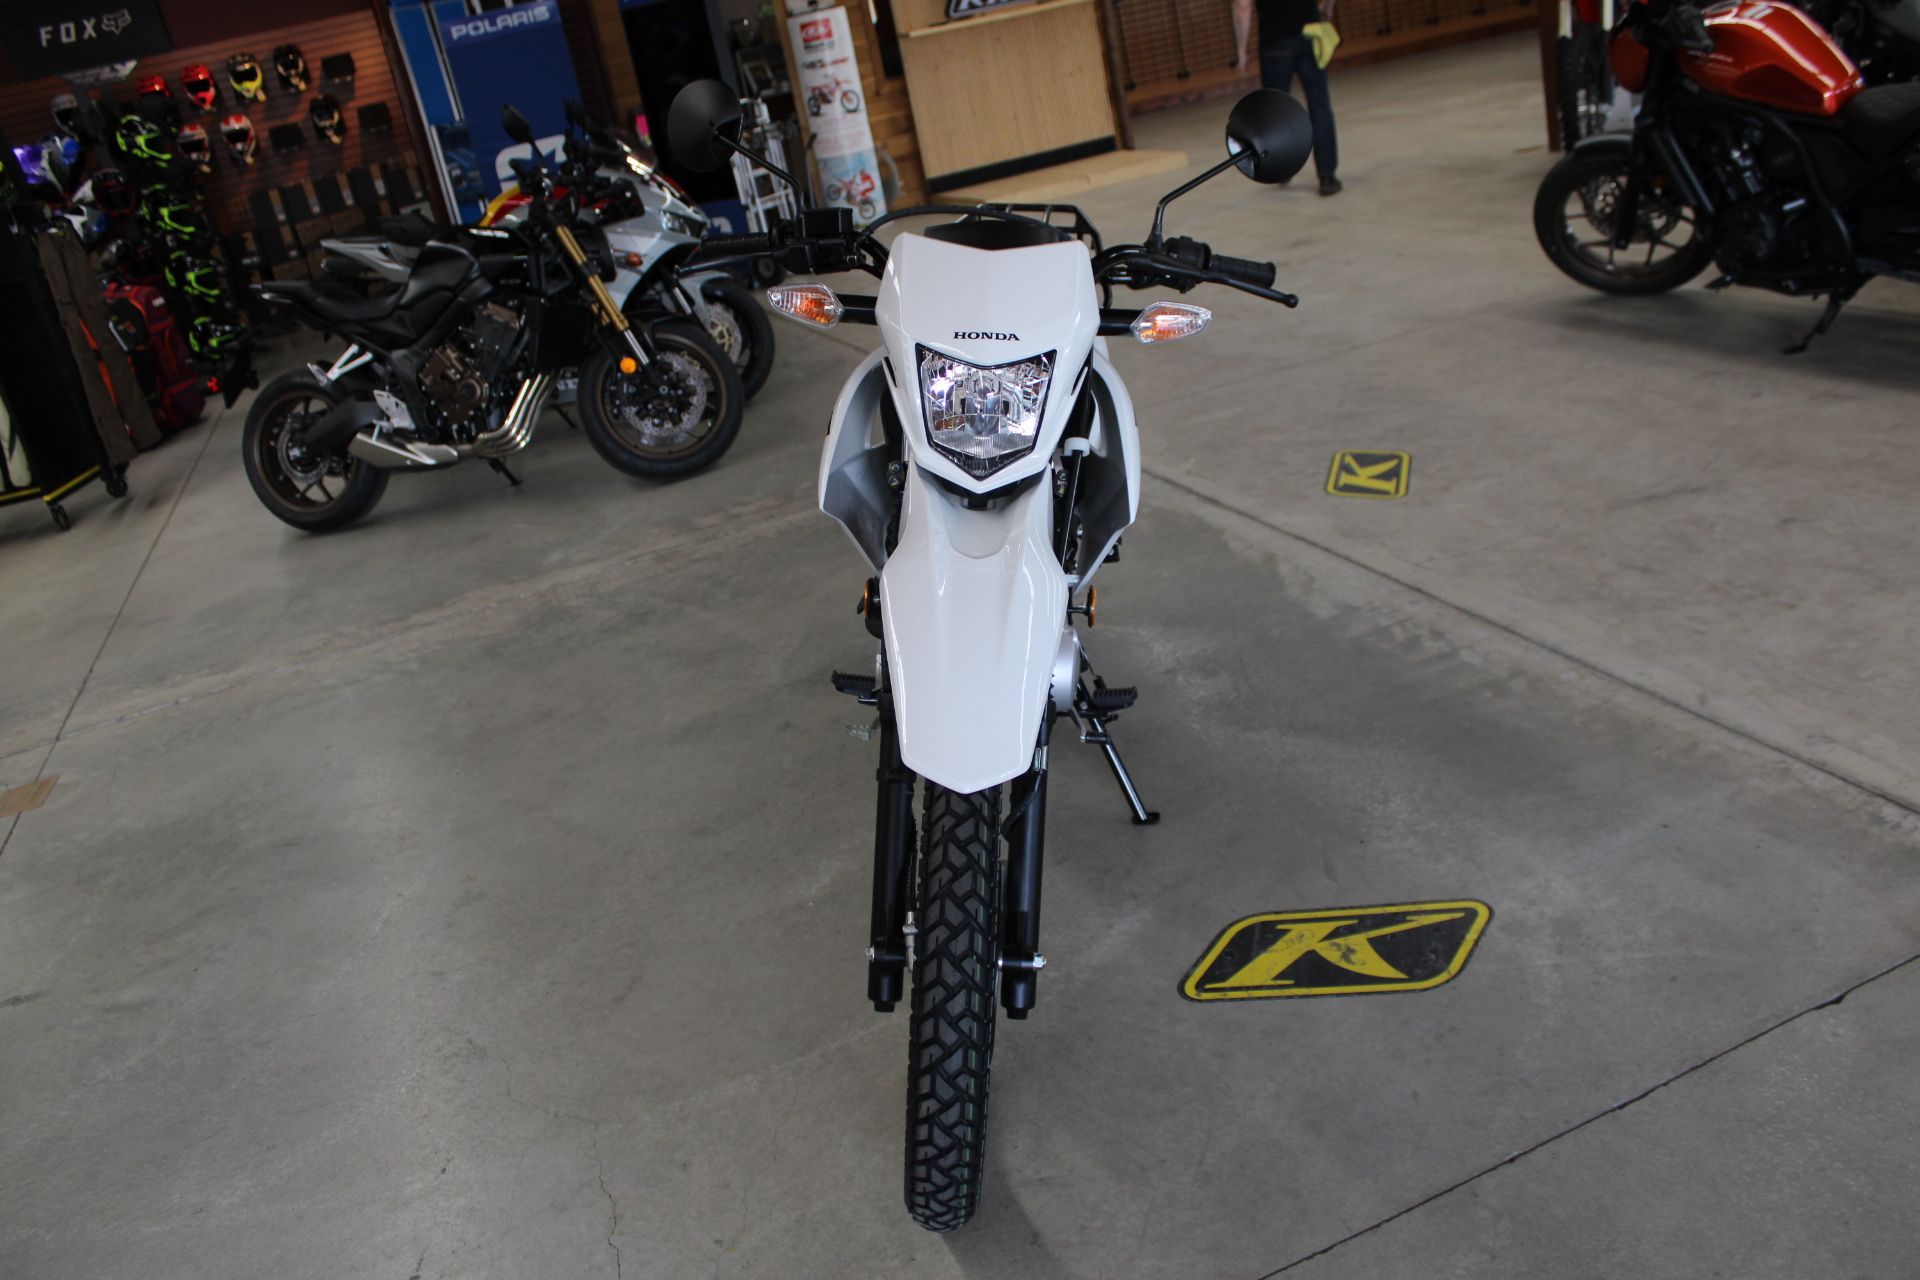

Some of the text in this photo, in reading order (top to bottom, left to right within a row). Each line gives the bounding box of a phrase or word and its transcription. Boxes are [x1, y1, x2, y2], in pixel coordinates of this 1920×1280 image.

[40, 17, 97, 48] FOX
[450, 5, 550, 40] POLARIS
[953, 331, 1020, 341] HONDA
[1339, 454, 1400, 495] K
[1204, 912, 1465, 988] K
